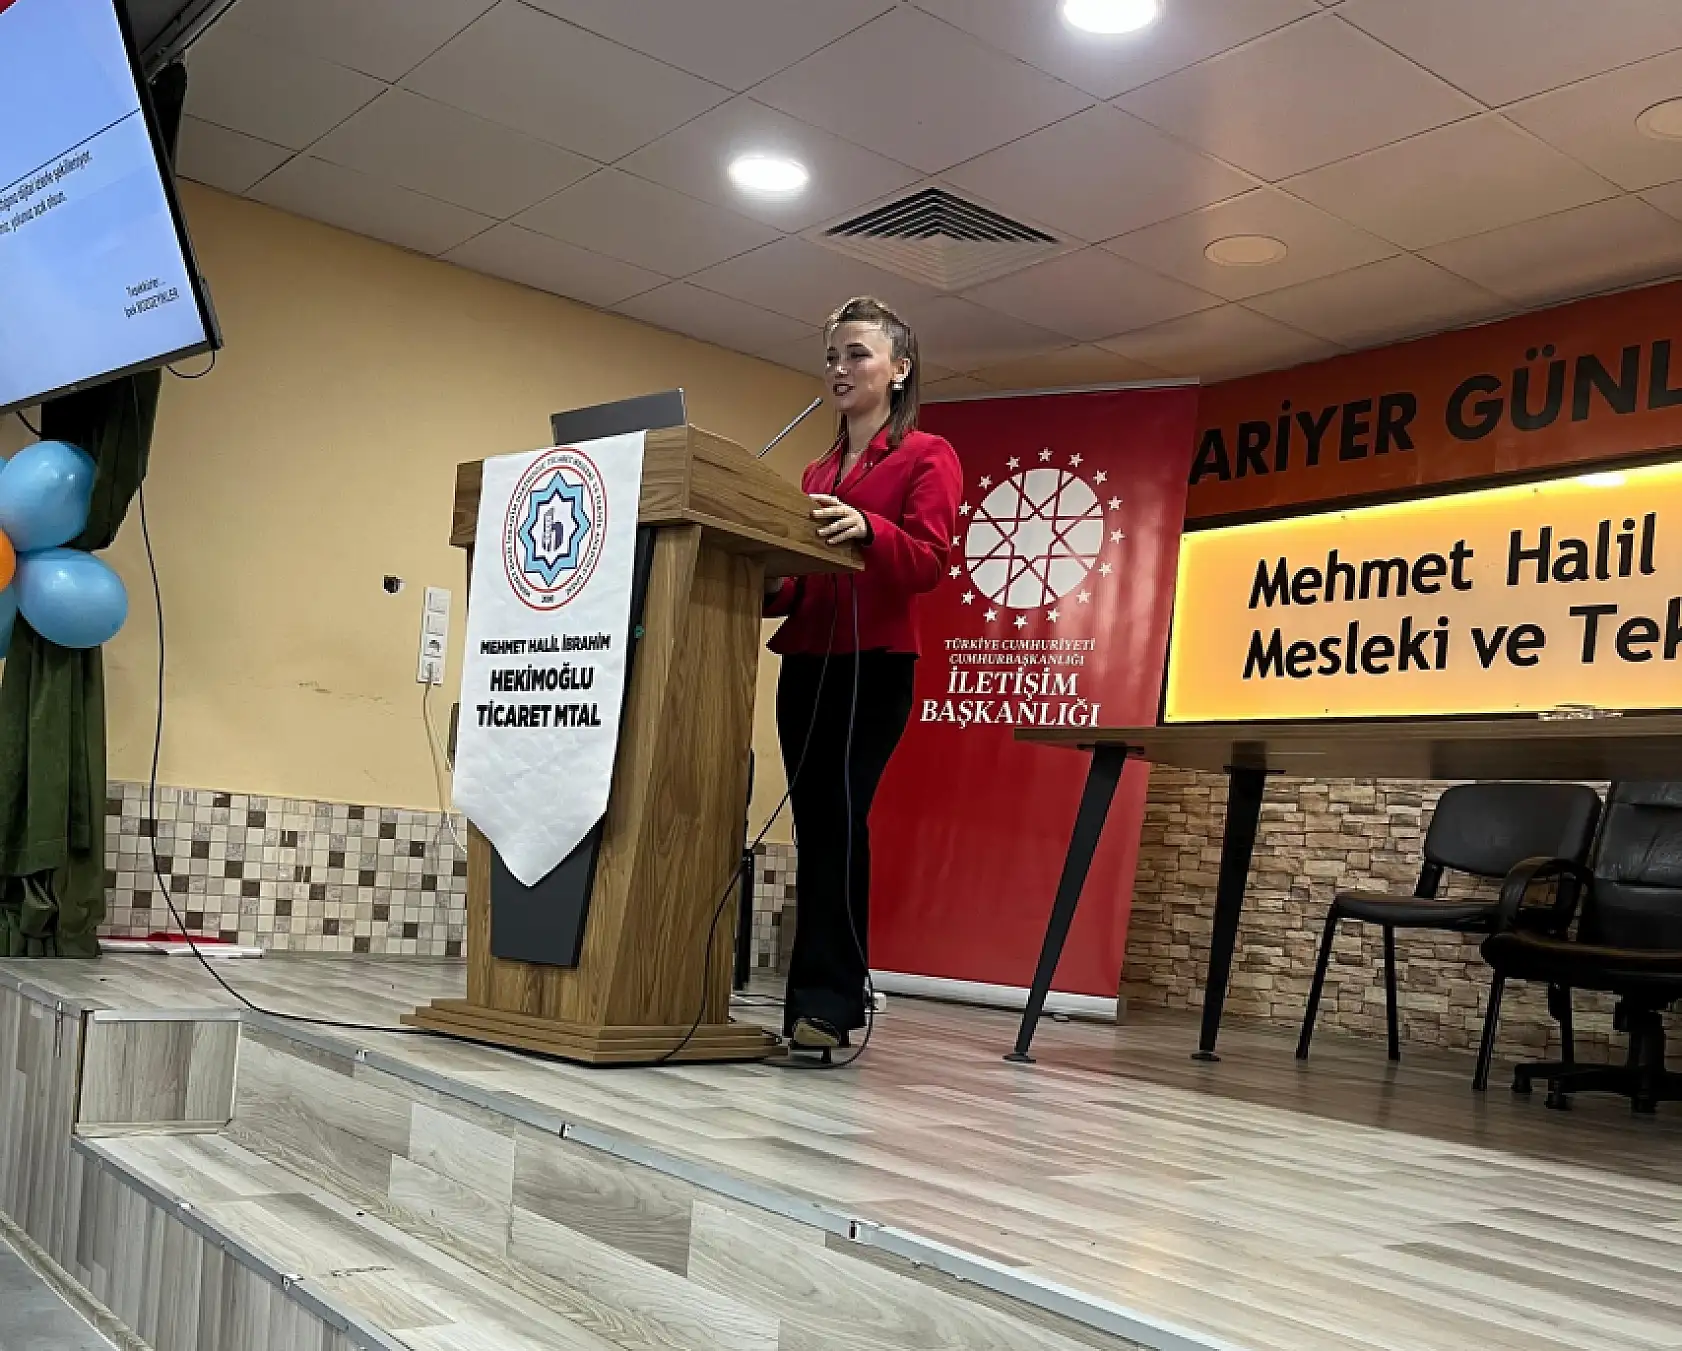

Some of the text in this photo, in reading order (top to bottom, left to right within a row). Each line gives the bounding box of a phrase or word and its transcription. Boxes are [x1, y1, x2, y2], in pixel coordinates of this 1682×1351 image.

[1445, 339, 1682, 442] GÜNL
[1248, 511, 1656, 610] Mehmet Halil
[480, 630, 611, 655] MEHMET HALİL İBRAHİM
[944, 637, 1096, 652] TÜRKİYE CUMHURİYETİ
[1242, 615, 1449, 680] Mesleki
[1471, 623, 1546, 670] ve
[948, 652, 1085, 667] CUMHURBAŞKANLIĞI
[490, 662, 594, 692] HEKİMOĞLU
[946, 665, 1078, 701] İLETİŞİM
[476, 699, 602, 728] TİCARET MTAL
[919, 697, 1101, 730] BAŞKANLIĞI
